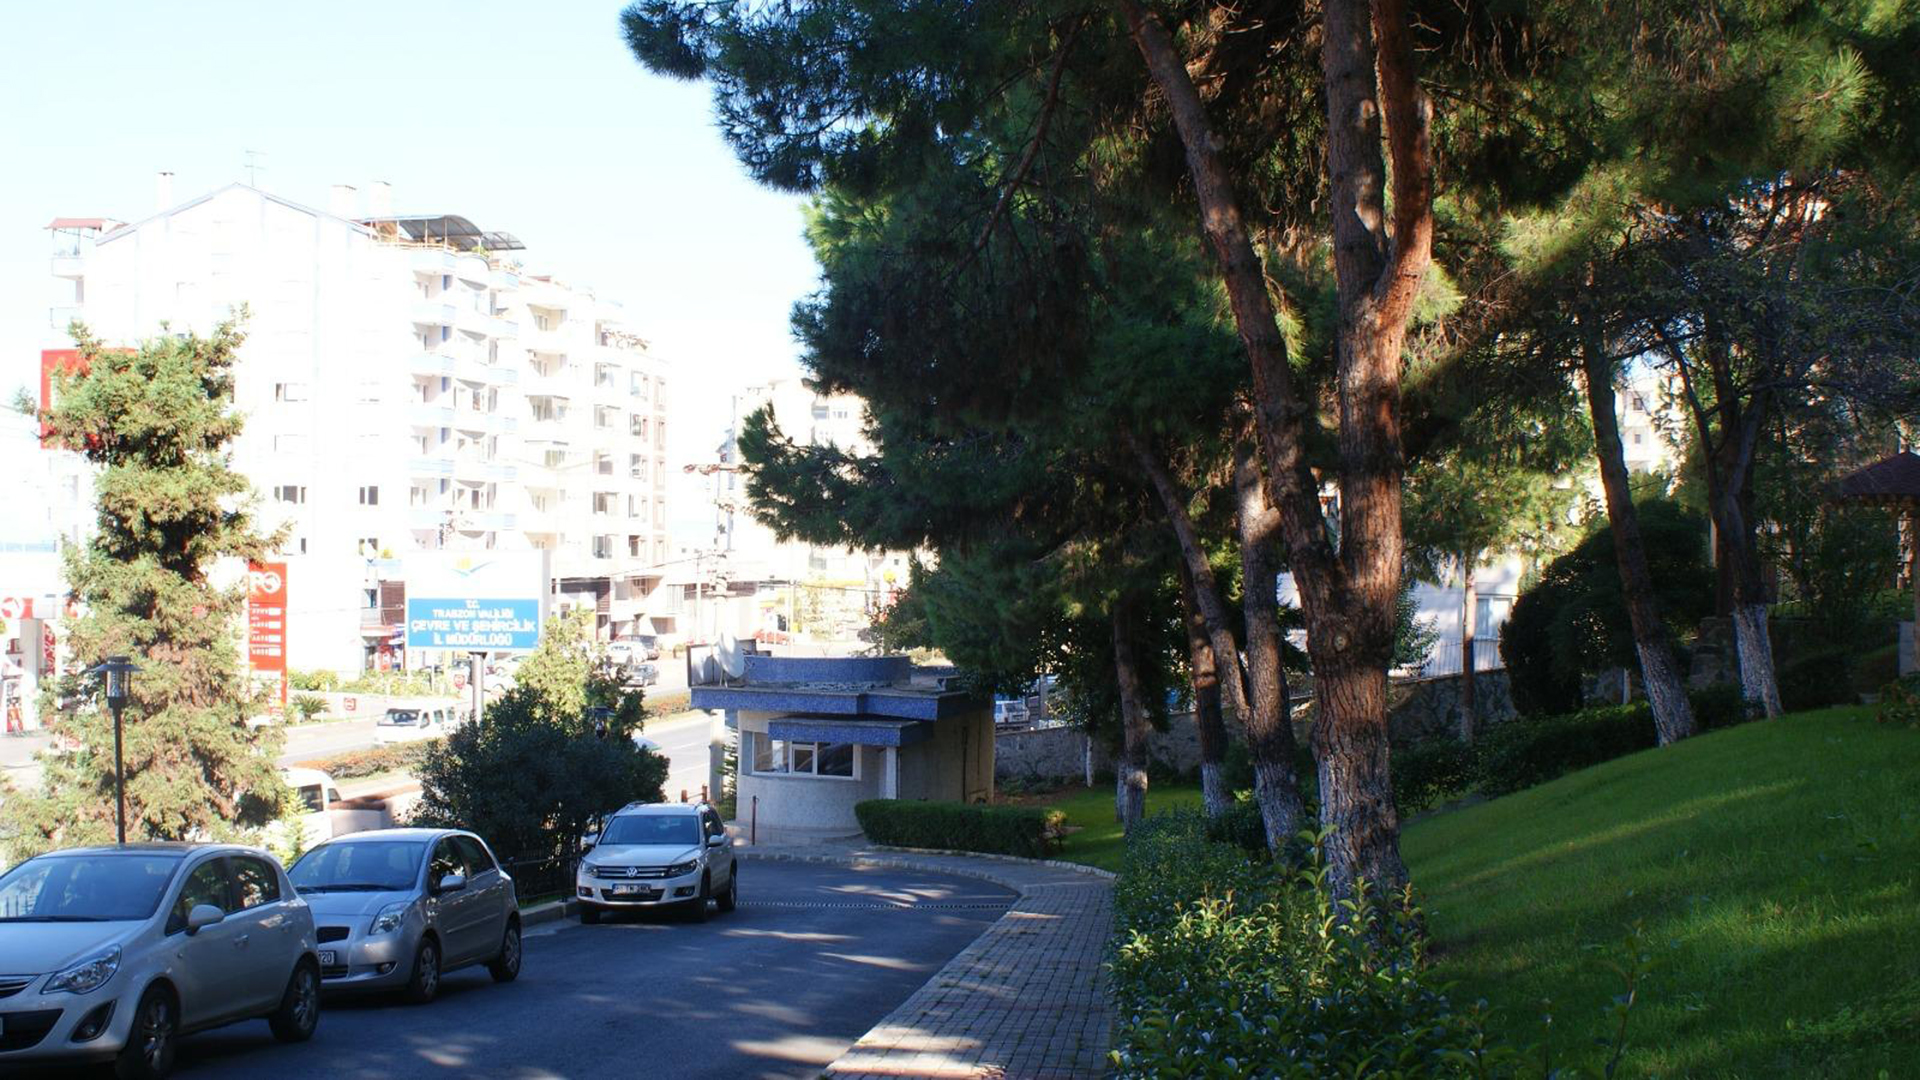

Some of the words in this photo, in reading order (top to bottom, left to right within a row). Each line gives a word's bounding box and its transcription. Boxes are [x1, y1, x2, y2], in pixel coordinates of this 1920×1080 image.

[433, 609, 475, 618] TRABZON
[411, 620, 450, 632] ÇEVRE
[455, 620, 470, 631] VE
